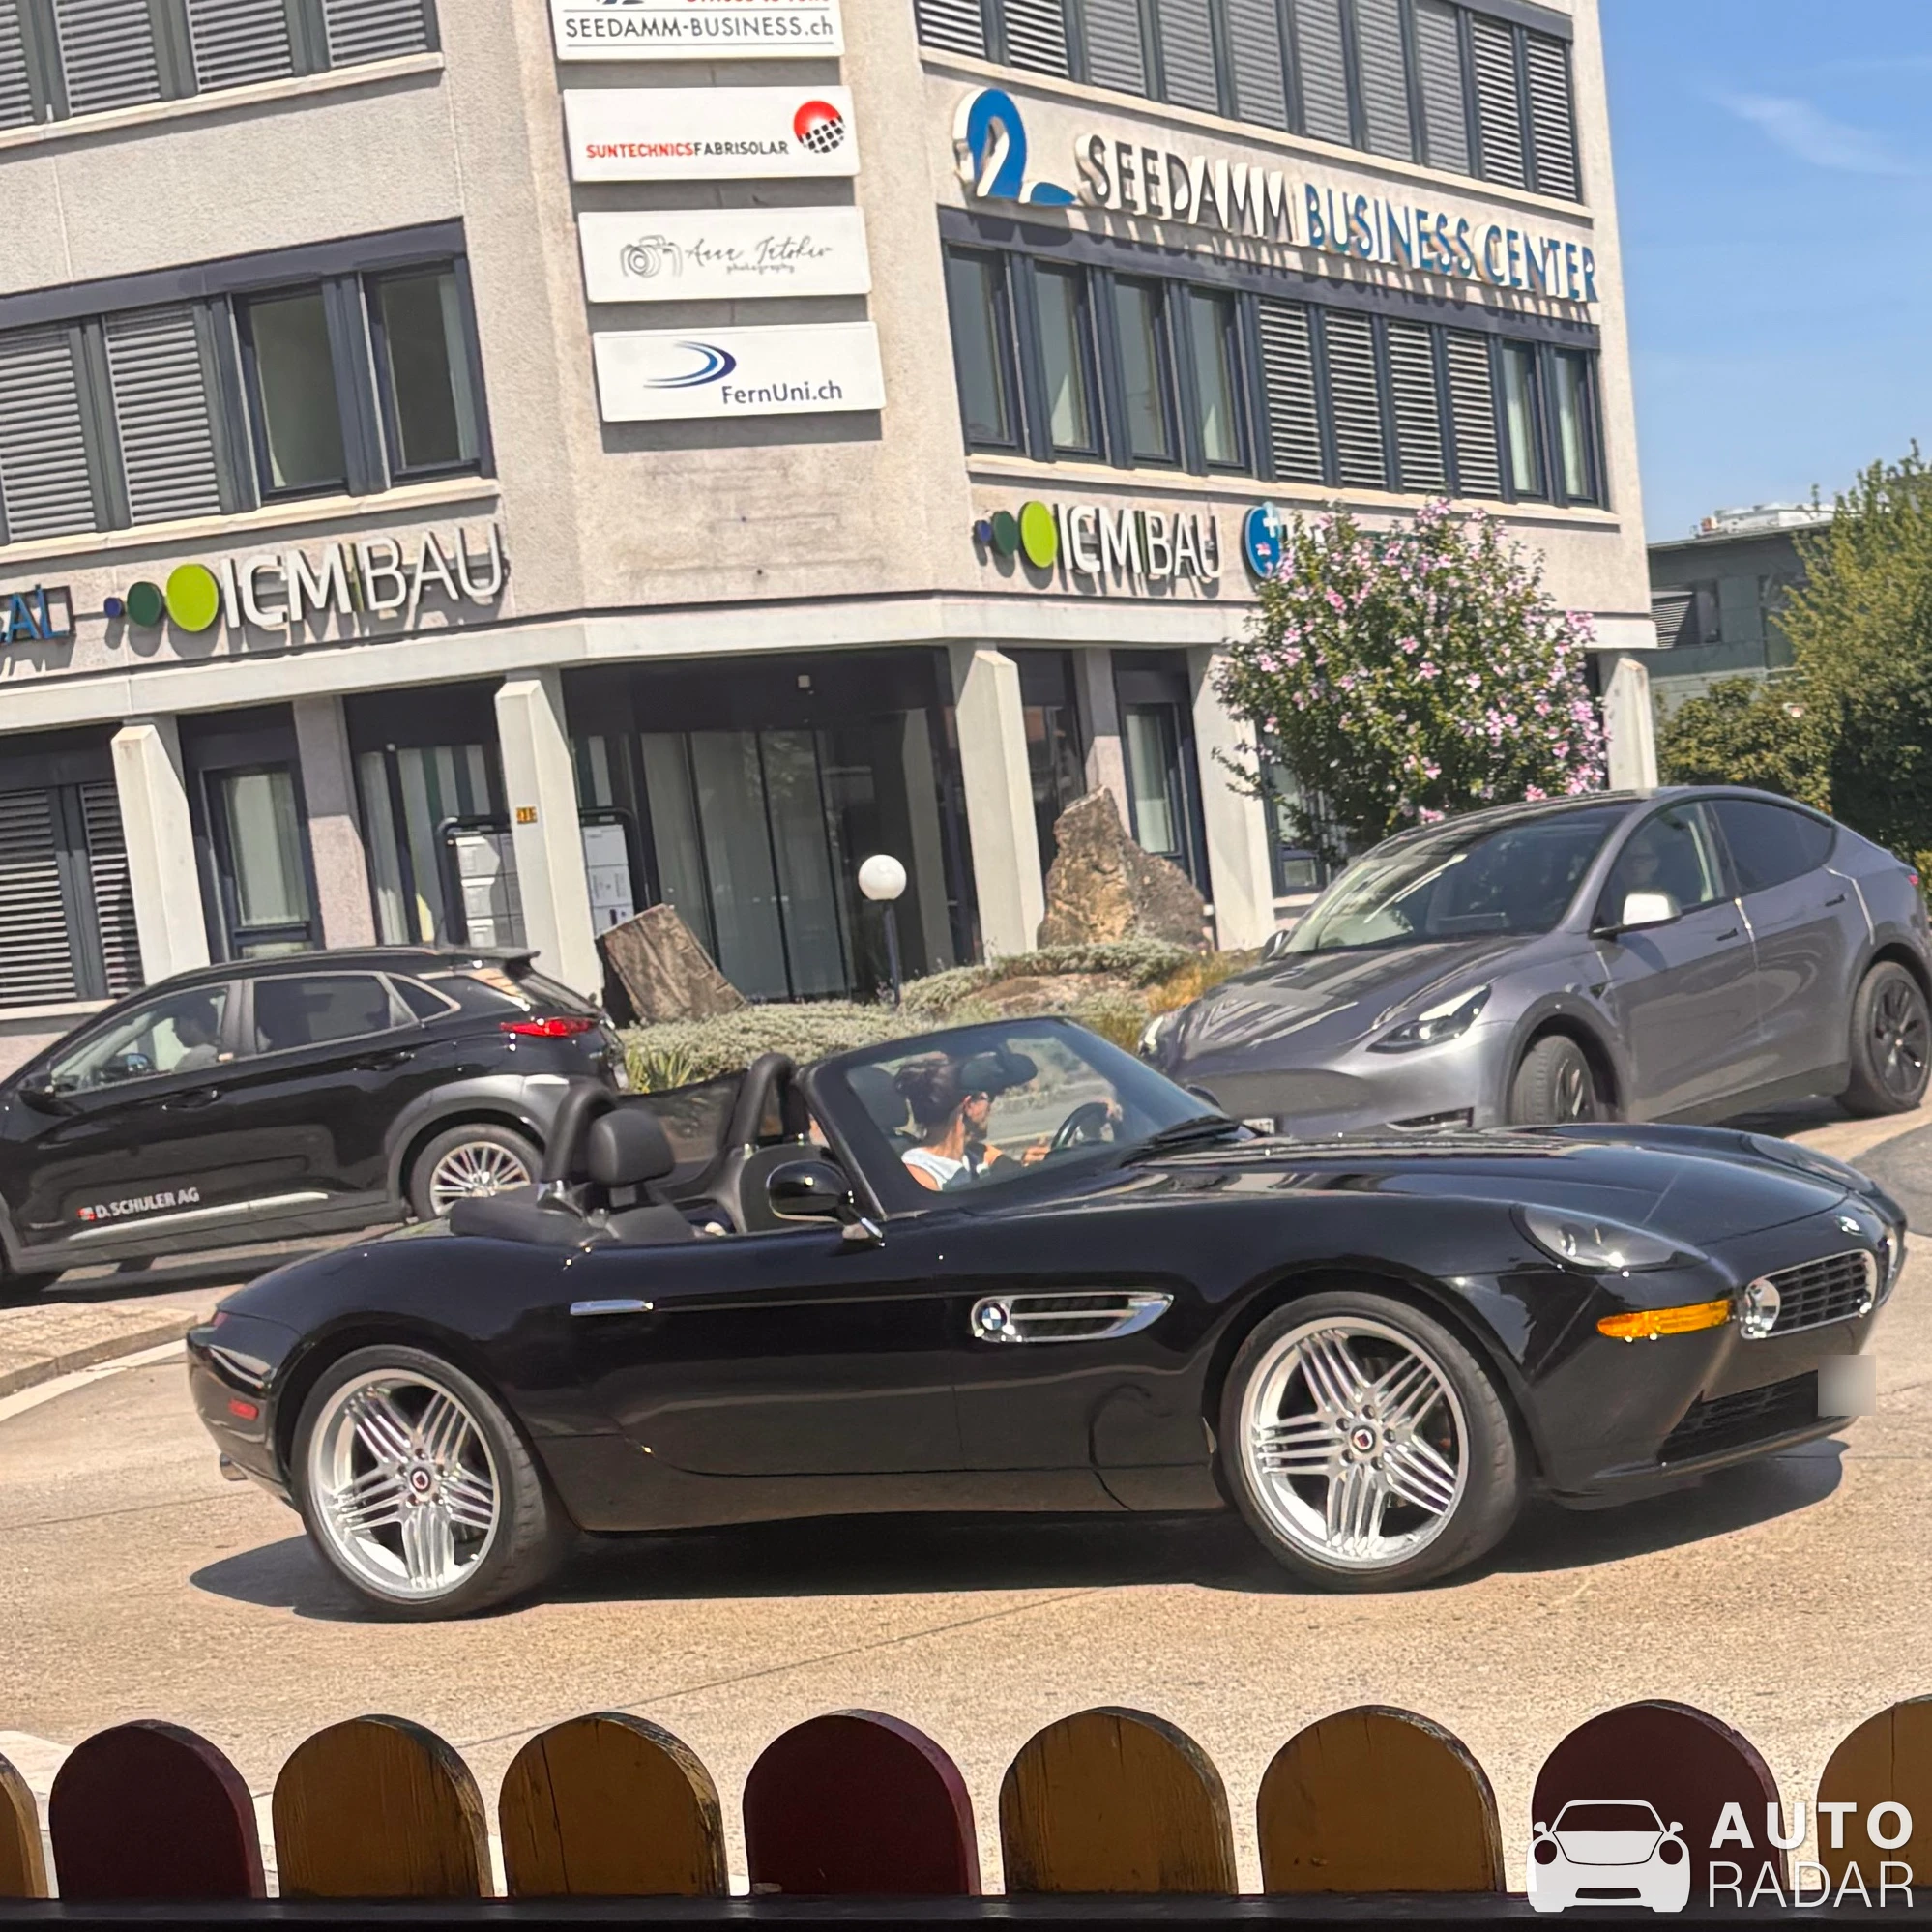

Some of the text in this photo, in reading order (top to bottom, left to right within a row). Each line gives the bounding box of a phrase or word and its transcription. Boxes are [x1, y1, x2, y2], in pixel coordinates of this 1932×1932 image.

[565, 16, 834, 38] SEEDAMM-BUSINESS.ch
[1076, 134, 1599, 302] SEEDAMM BUSINESS CENTER
[721, 380, 843, 404] FernUni.ch
[178, 1186, 200, 1205] AG
